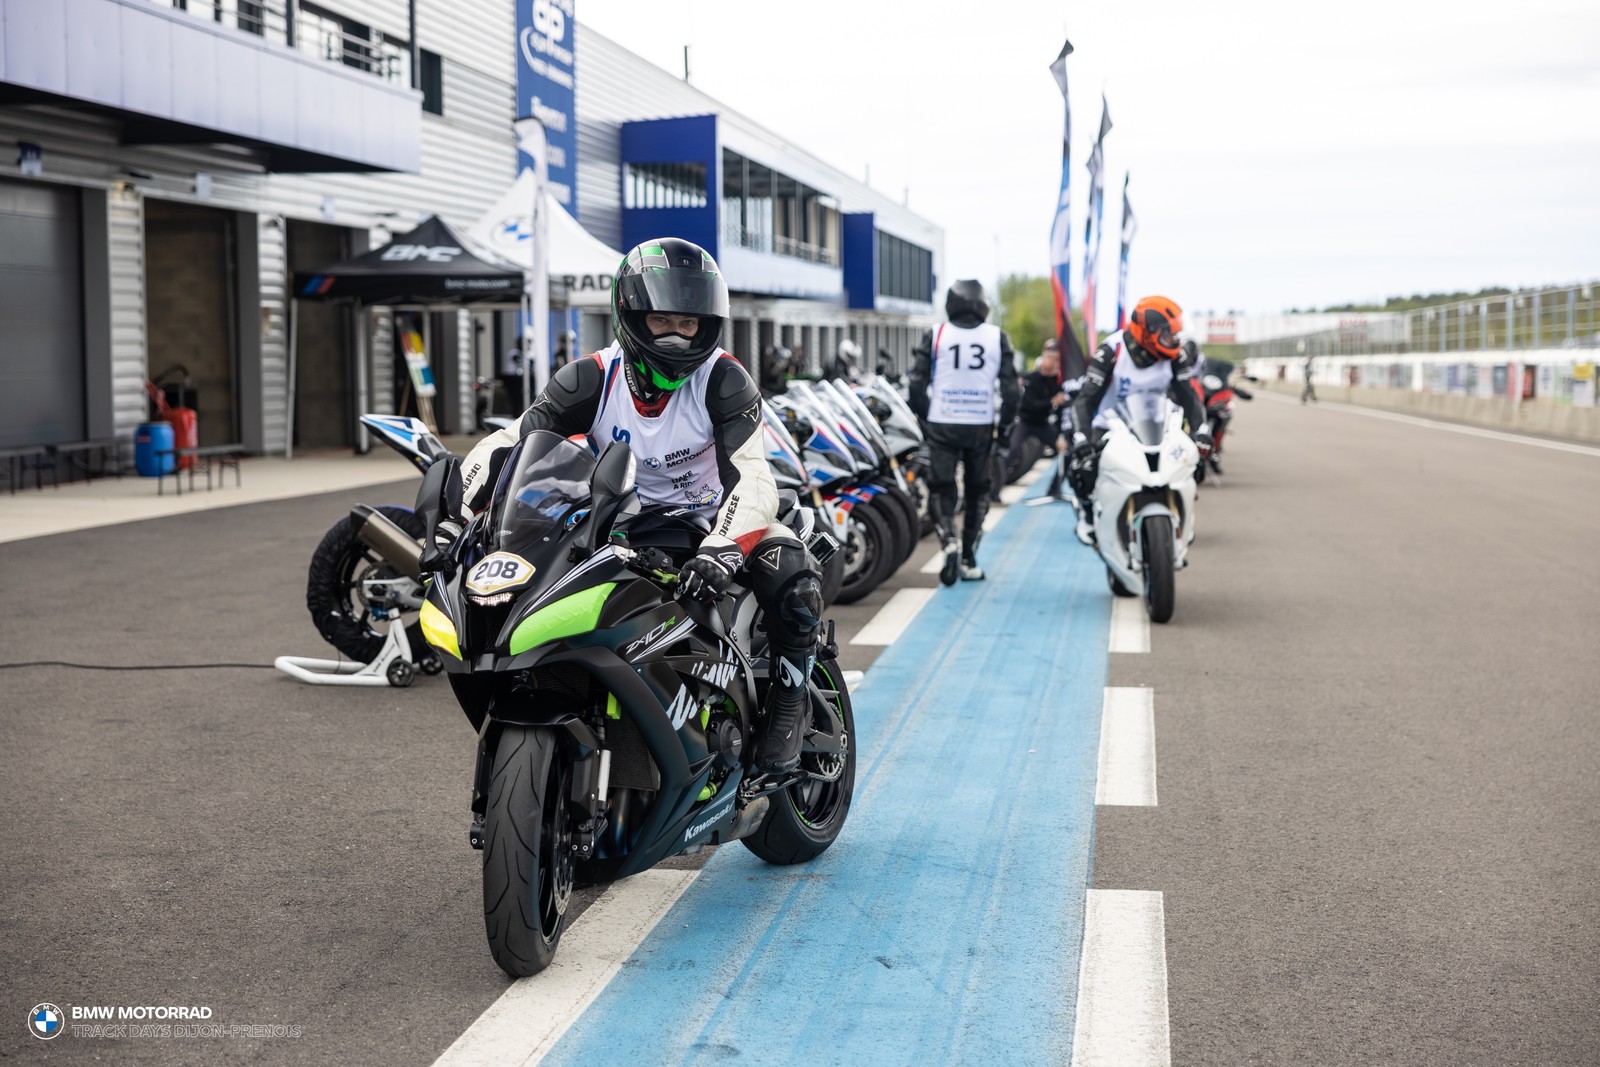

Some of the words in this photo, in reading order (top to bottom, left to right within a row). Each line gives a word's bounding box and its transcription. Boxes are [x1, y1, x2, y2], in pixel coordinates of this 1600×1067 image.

[381, 244, 463, 262] BMC
[949, 344, 985, 370] 13
[664, 448, 690, 462] BMW
[718, 495, 740, 537] DAINESE
[473, 559, 519, 582] 208
[684, 800, 735, 842] Kawasaki
